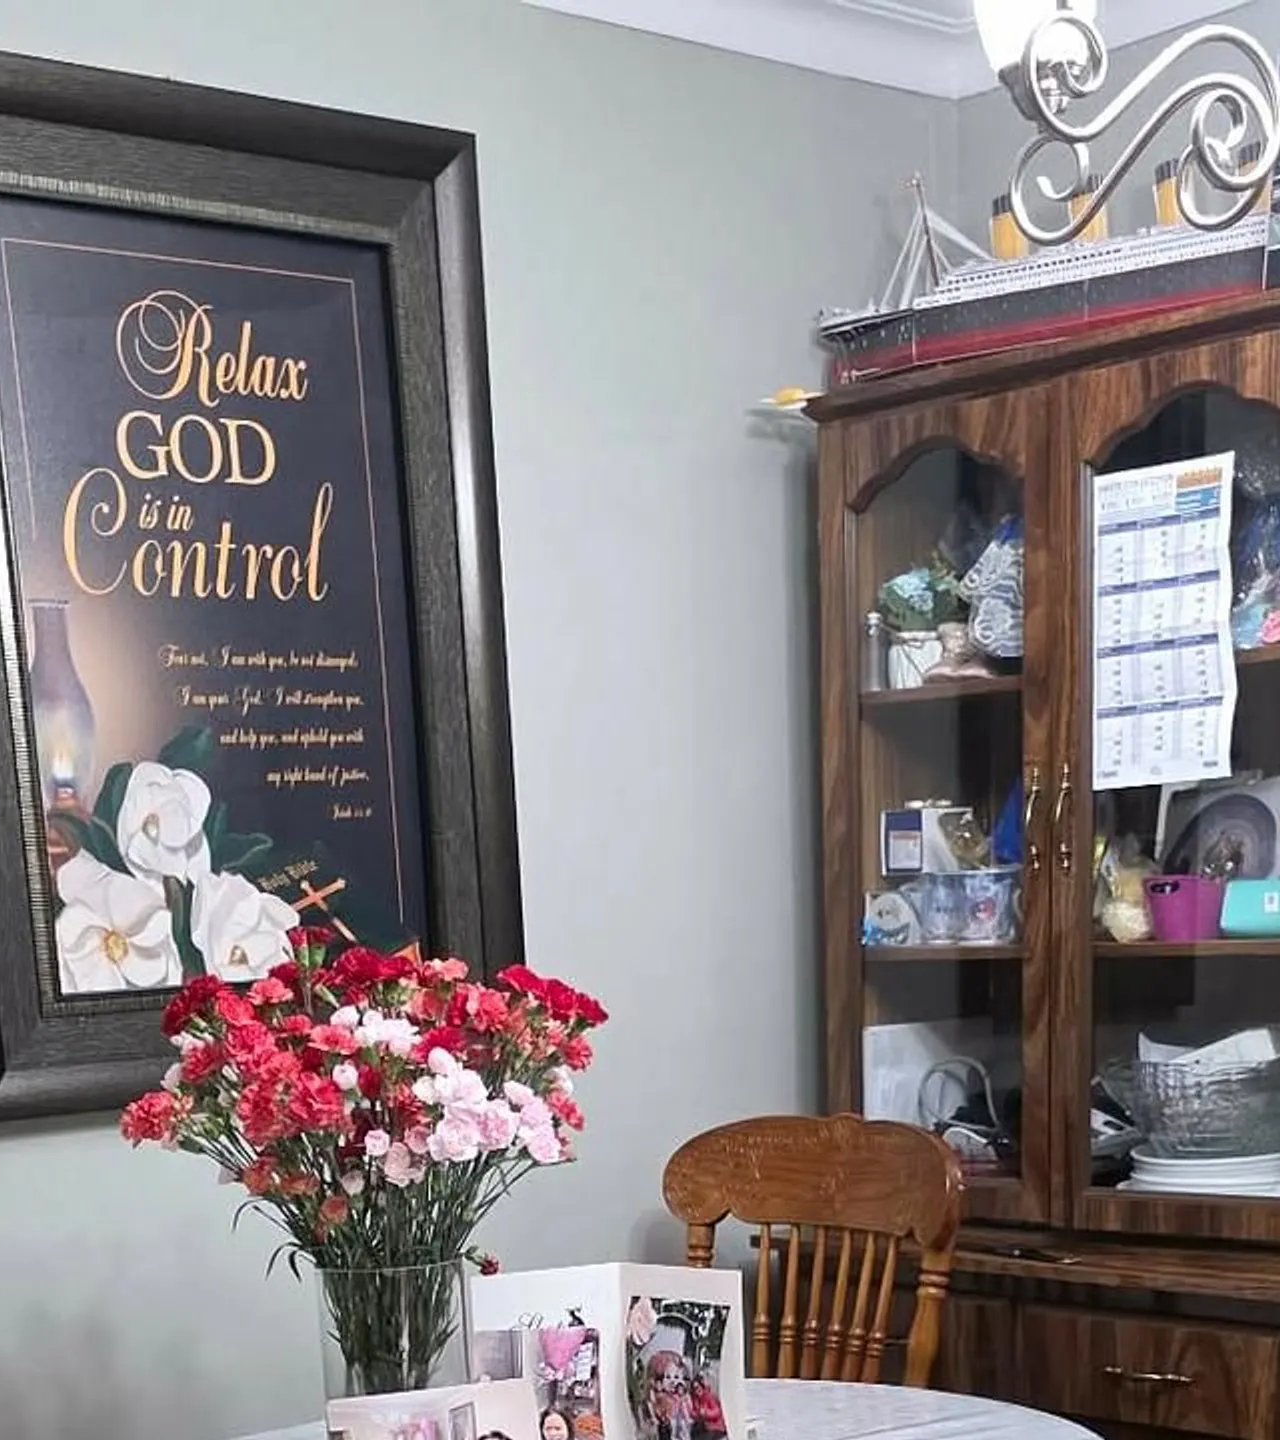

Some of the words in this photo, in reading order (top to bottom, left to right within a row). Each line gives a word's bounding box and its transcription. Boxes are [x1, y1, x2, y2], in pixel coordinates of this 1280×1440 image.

[116, 290, 309, 408] Relax
[116, 409, 277, 486] GOD
[63, 468, 334, 602] Control
[138, 493, 161, 531] is
[166, 495, 194, 532] in
